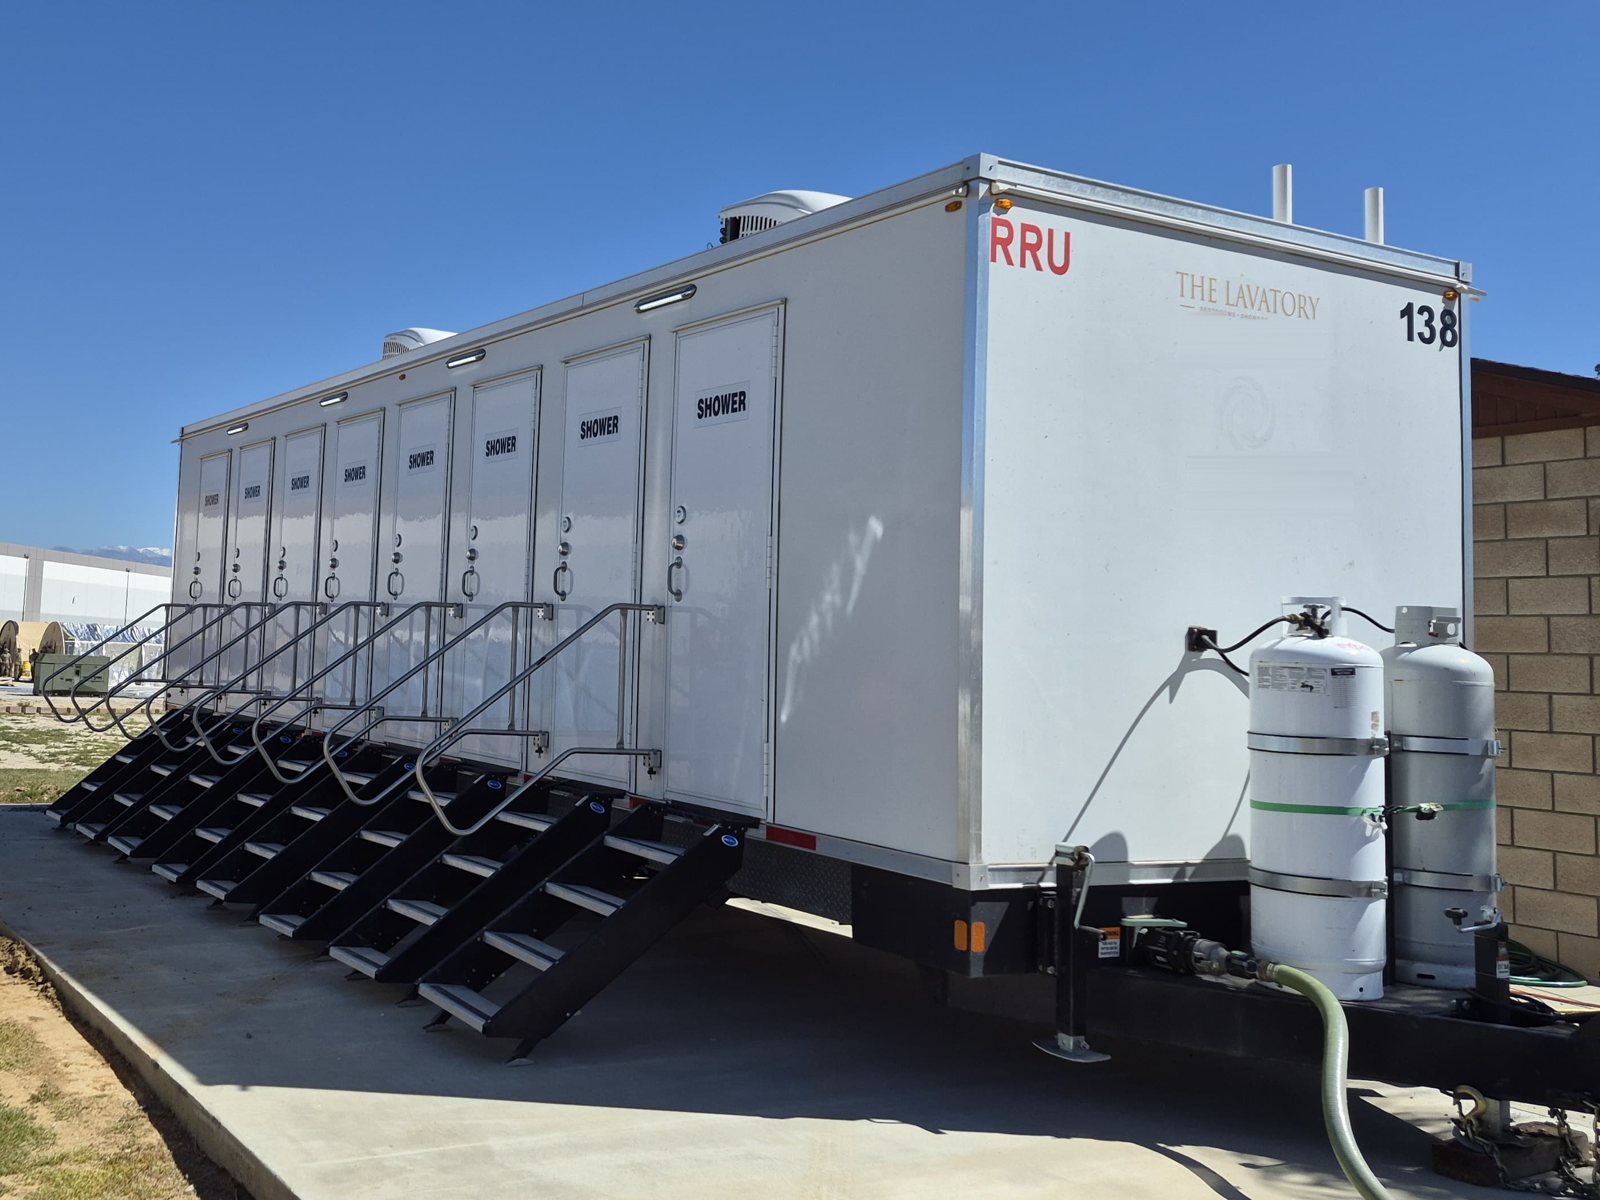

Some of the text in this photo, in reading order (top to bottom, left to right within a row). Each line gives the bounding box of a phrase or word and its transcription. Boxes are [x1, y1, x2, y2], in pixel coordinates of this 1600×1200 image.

[990, 217, 1071, 275] RRU
[1176, 271, 1217, 303] THE
[1225, 281, 1320, 320] LAVATORY
[1400, 302, 1458, 348] 138
[697, 391, 746, 419] SHOWER
[580, 415, 619, 440] SHOWER
[485, 436, 517, 457] SHOWER
[409, 450, 434, 469] SHOWER
[291, 475, 310, 491] SHOWER
[344, 465, 366, 482] SHOWER
[244, 485, 261, 499] SHOWER
